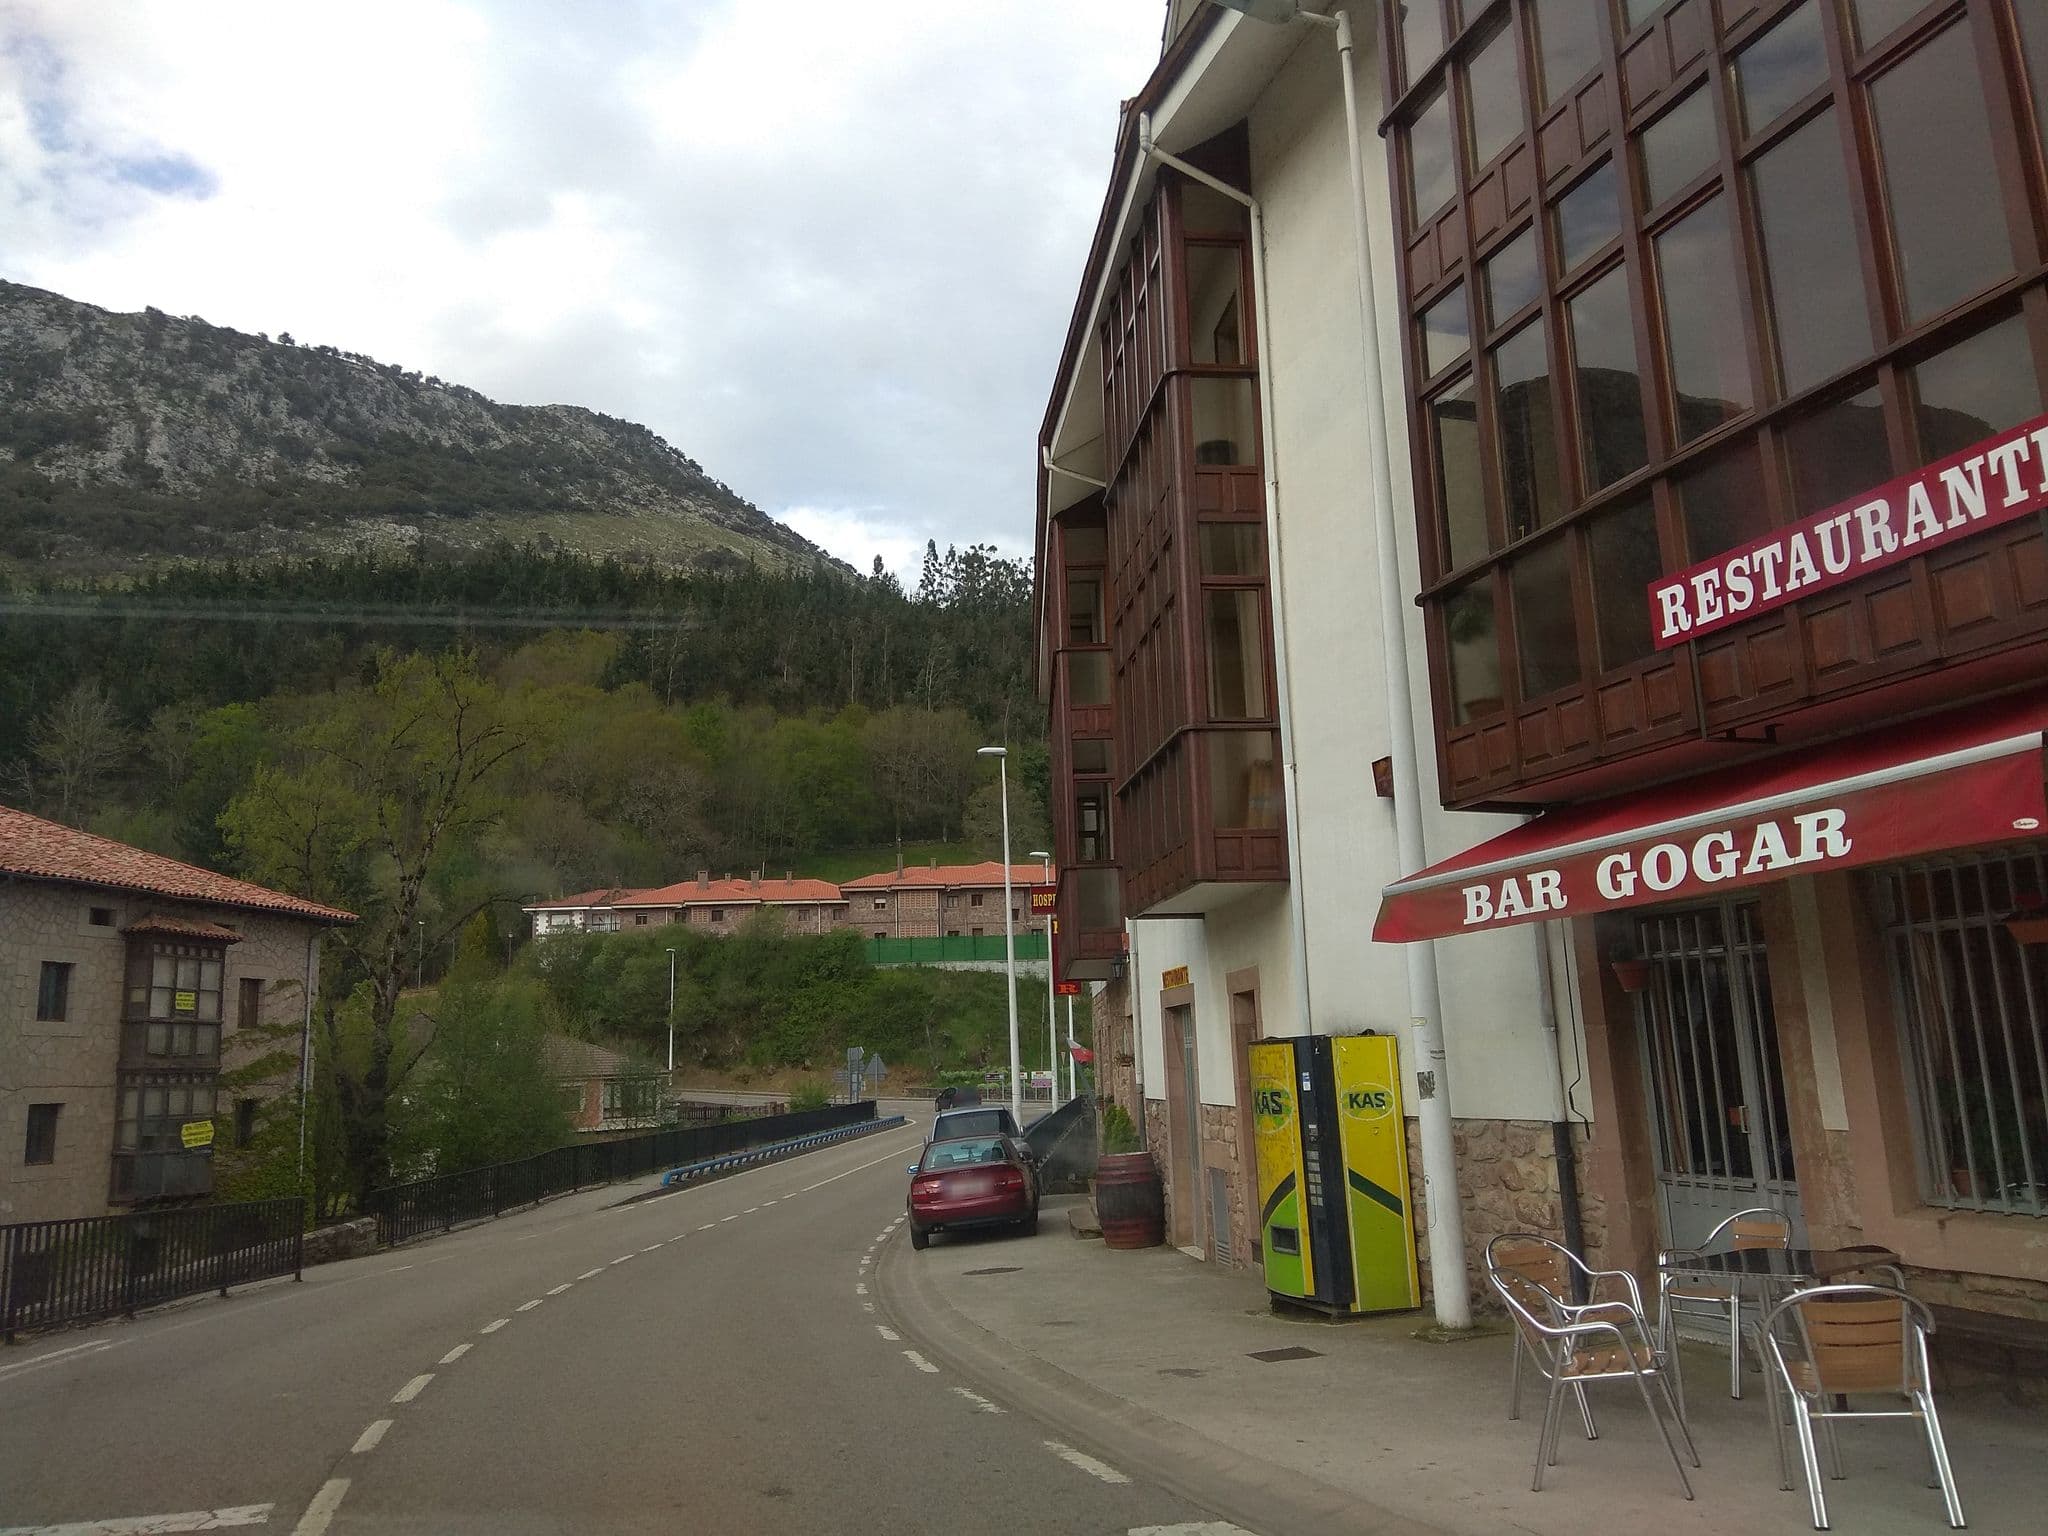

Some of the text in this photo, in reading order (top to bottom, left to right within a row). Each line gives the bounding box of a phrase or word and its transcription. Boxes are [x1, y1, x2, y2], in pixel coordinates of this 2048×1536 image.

[1461, 808, 1853, 926] BAR GOGAR
[1254, 1091, 1283, 1115] KAS
[1348, 1091, 1386, 1110] KAS
